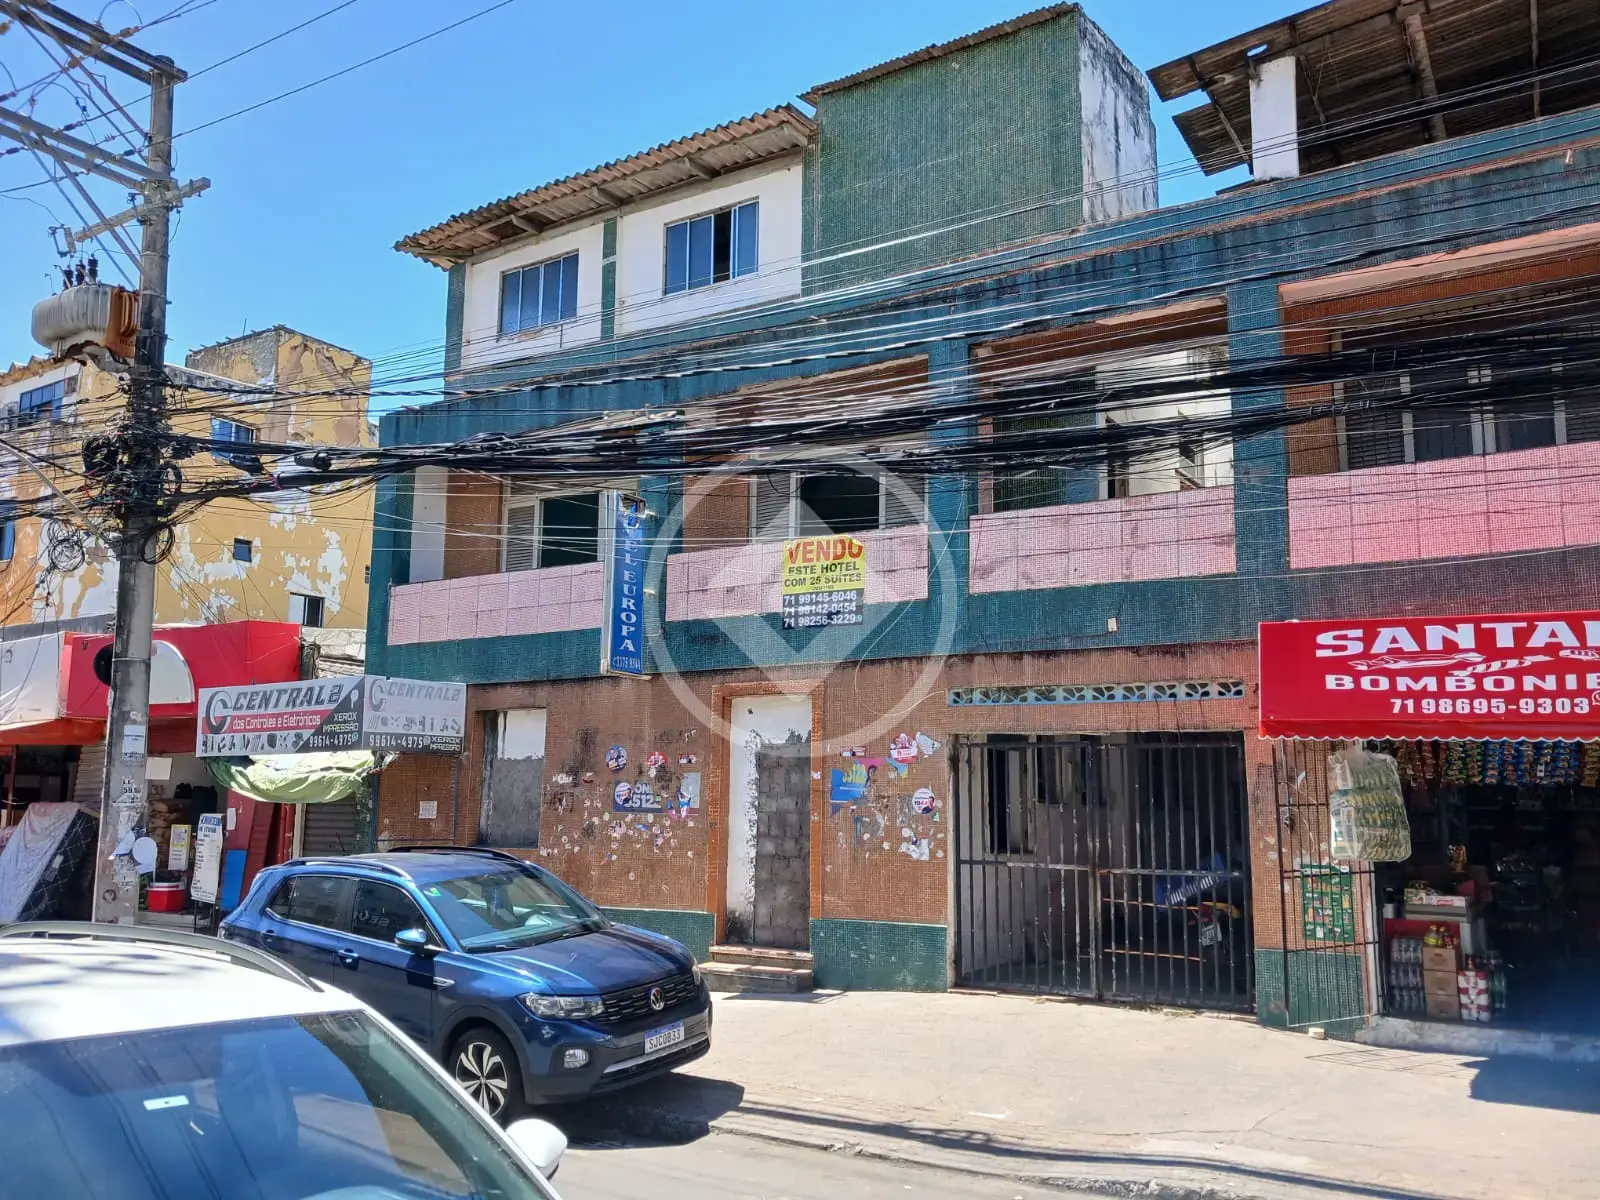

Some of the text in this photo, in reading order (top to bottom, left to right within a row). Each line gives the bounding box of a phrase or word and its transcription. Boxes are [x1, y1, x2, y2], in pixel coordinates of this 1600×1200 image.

[788, 538, 863, 565] VENDO
[788, 561, 860, 577] ESTE HOTEL
[784, 577, 807, 588] COM
[809, 576, 821, 586] 25
[784, 595, 795, 606] 71
[619, 569, 637, 653] EUROPA
[784, 606, 795, 617] 71
[783, 618, 795, 629] 71
[232, 717, 245, 730] dos
[245, 715, 276, 729] Controles
[277, 718, 283, 727] e
[333, 711, 357, 722] XEROX
[369, 734, 423, 749] 99614-4975
[431, 735, 461, 744] XEROX
